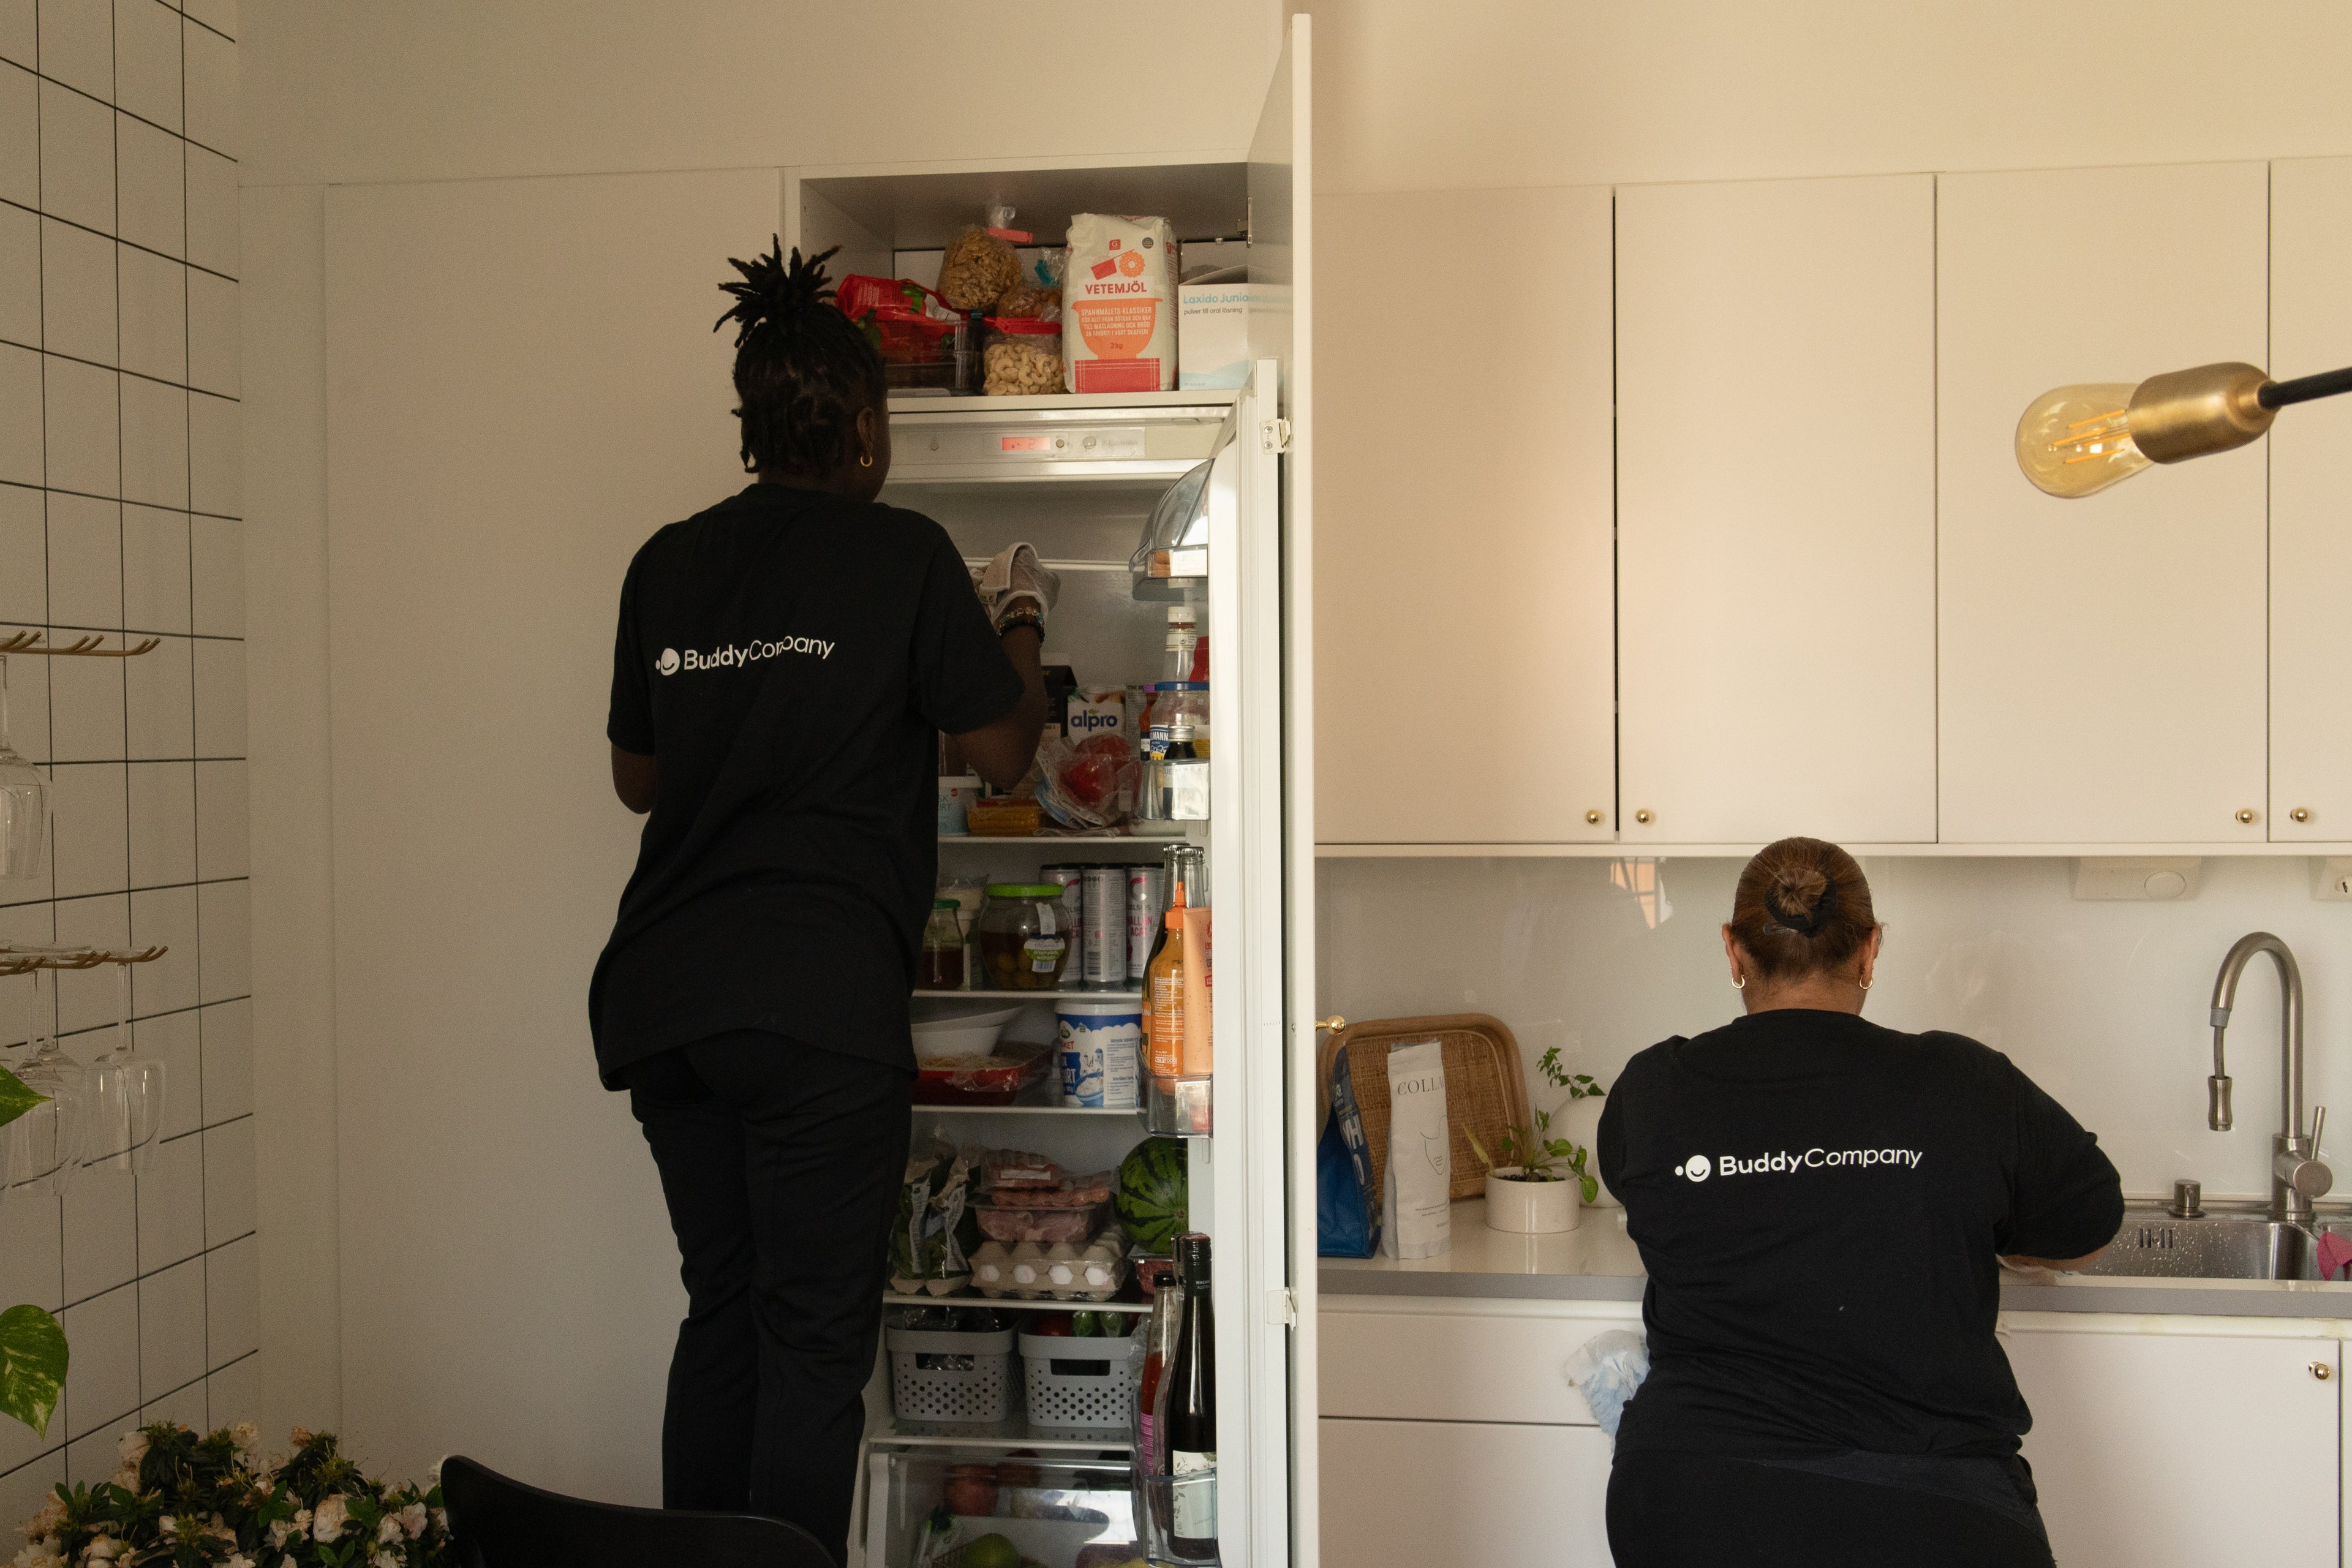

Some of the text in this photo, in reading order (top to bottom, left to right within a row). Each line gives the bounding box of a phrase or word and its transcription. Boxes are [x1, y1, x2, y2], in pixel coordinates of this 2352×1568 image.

[1085, 281, 1147, 295] VETEMJÖL
[1183, 293, 1250, 304] Laxido Junio
[1081, 307, 1121, 316] SPANNMÅLETS
[1071, 709, 1118, 732] alpro
[1719, 1148, 1923, 1177] BuddyCompany
